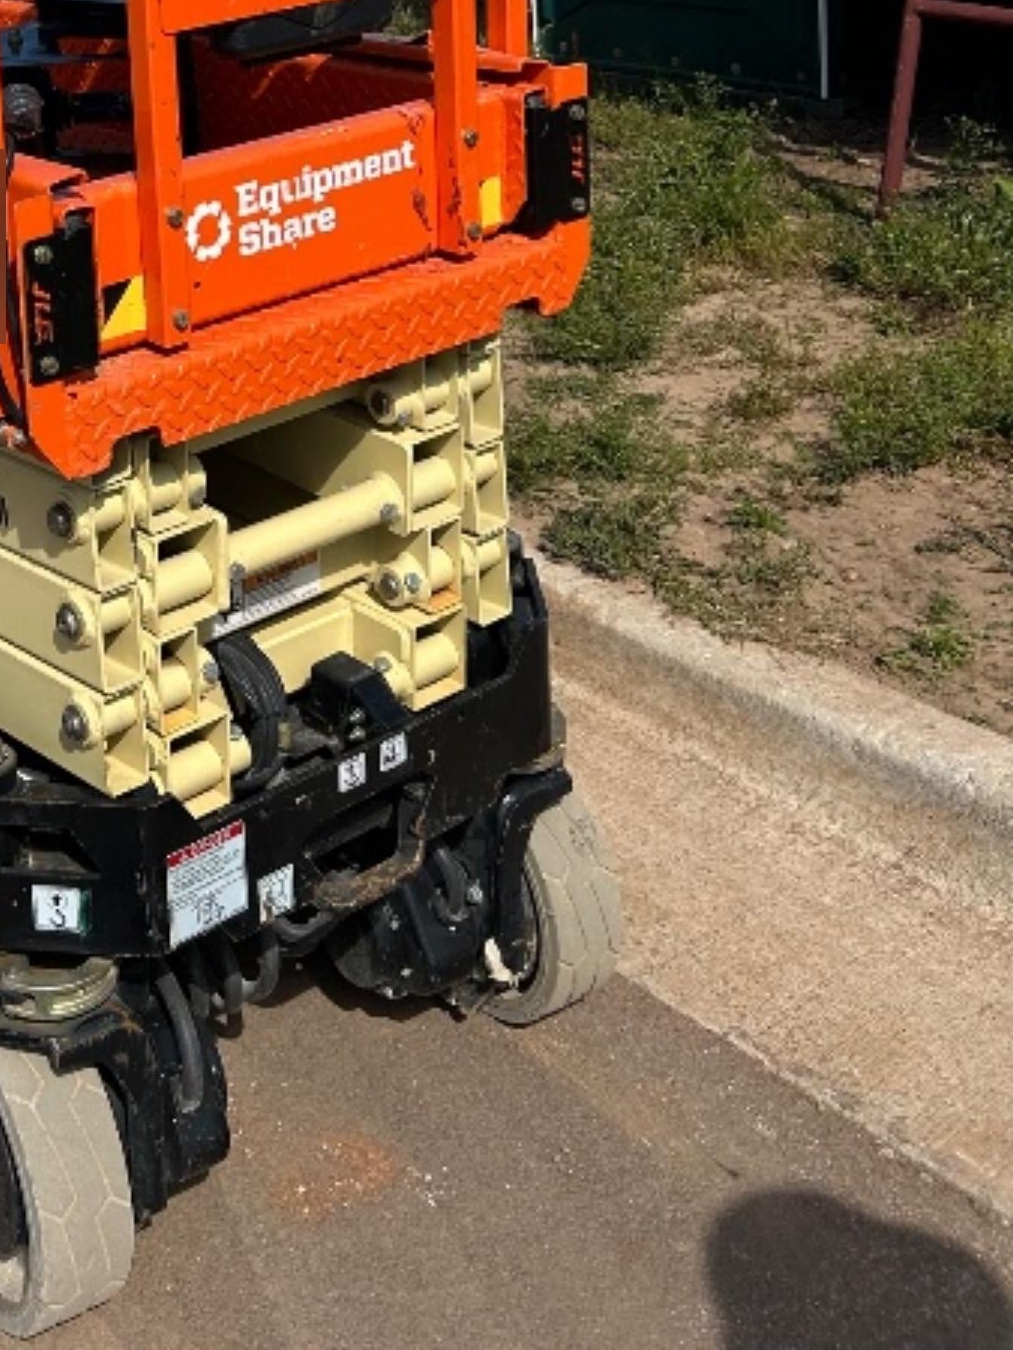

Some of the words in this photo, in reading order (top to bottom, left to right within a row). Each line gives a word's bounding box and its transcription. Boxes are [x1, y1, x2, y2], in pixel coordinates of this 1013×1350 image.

[234, 139, 415, 217] Equipment
[238, 206, 336, 256] Share
[32, 281, 54, 346] JLG
